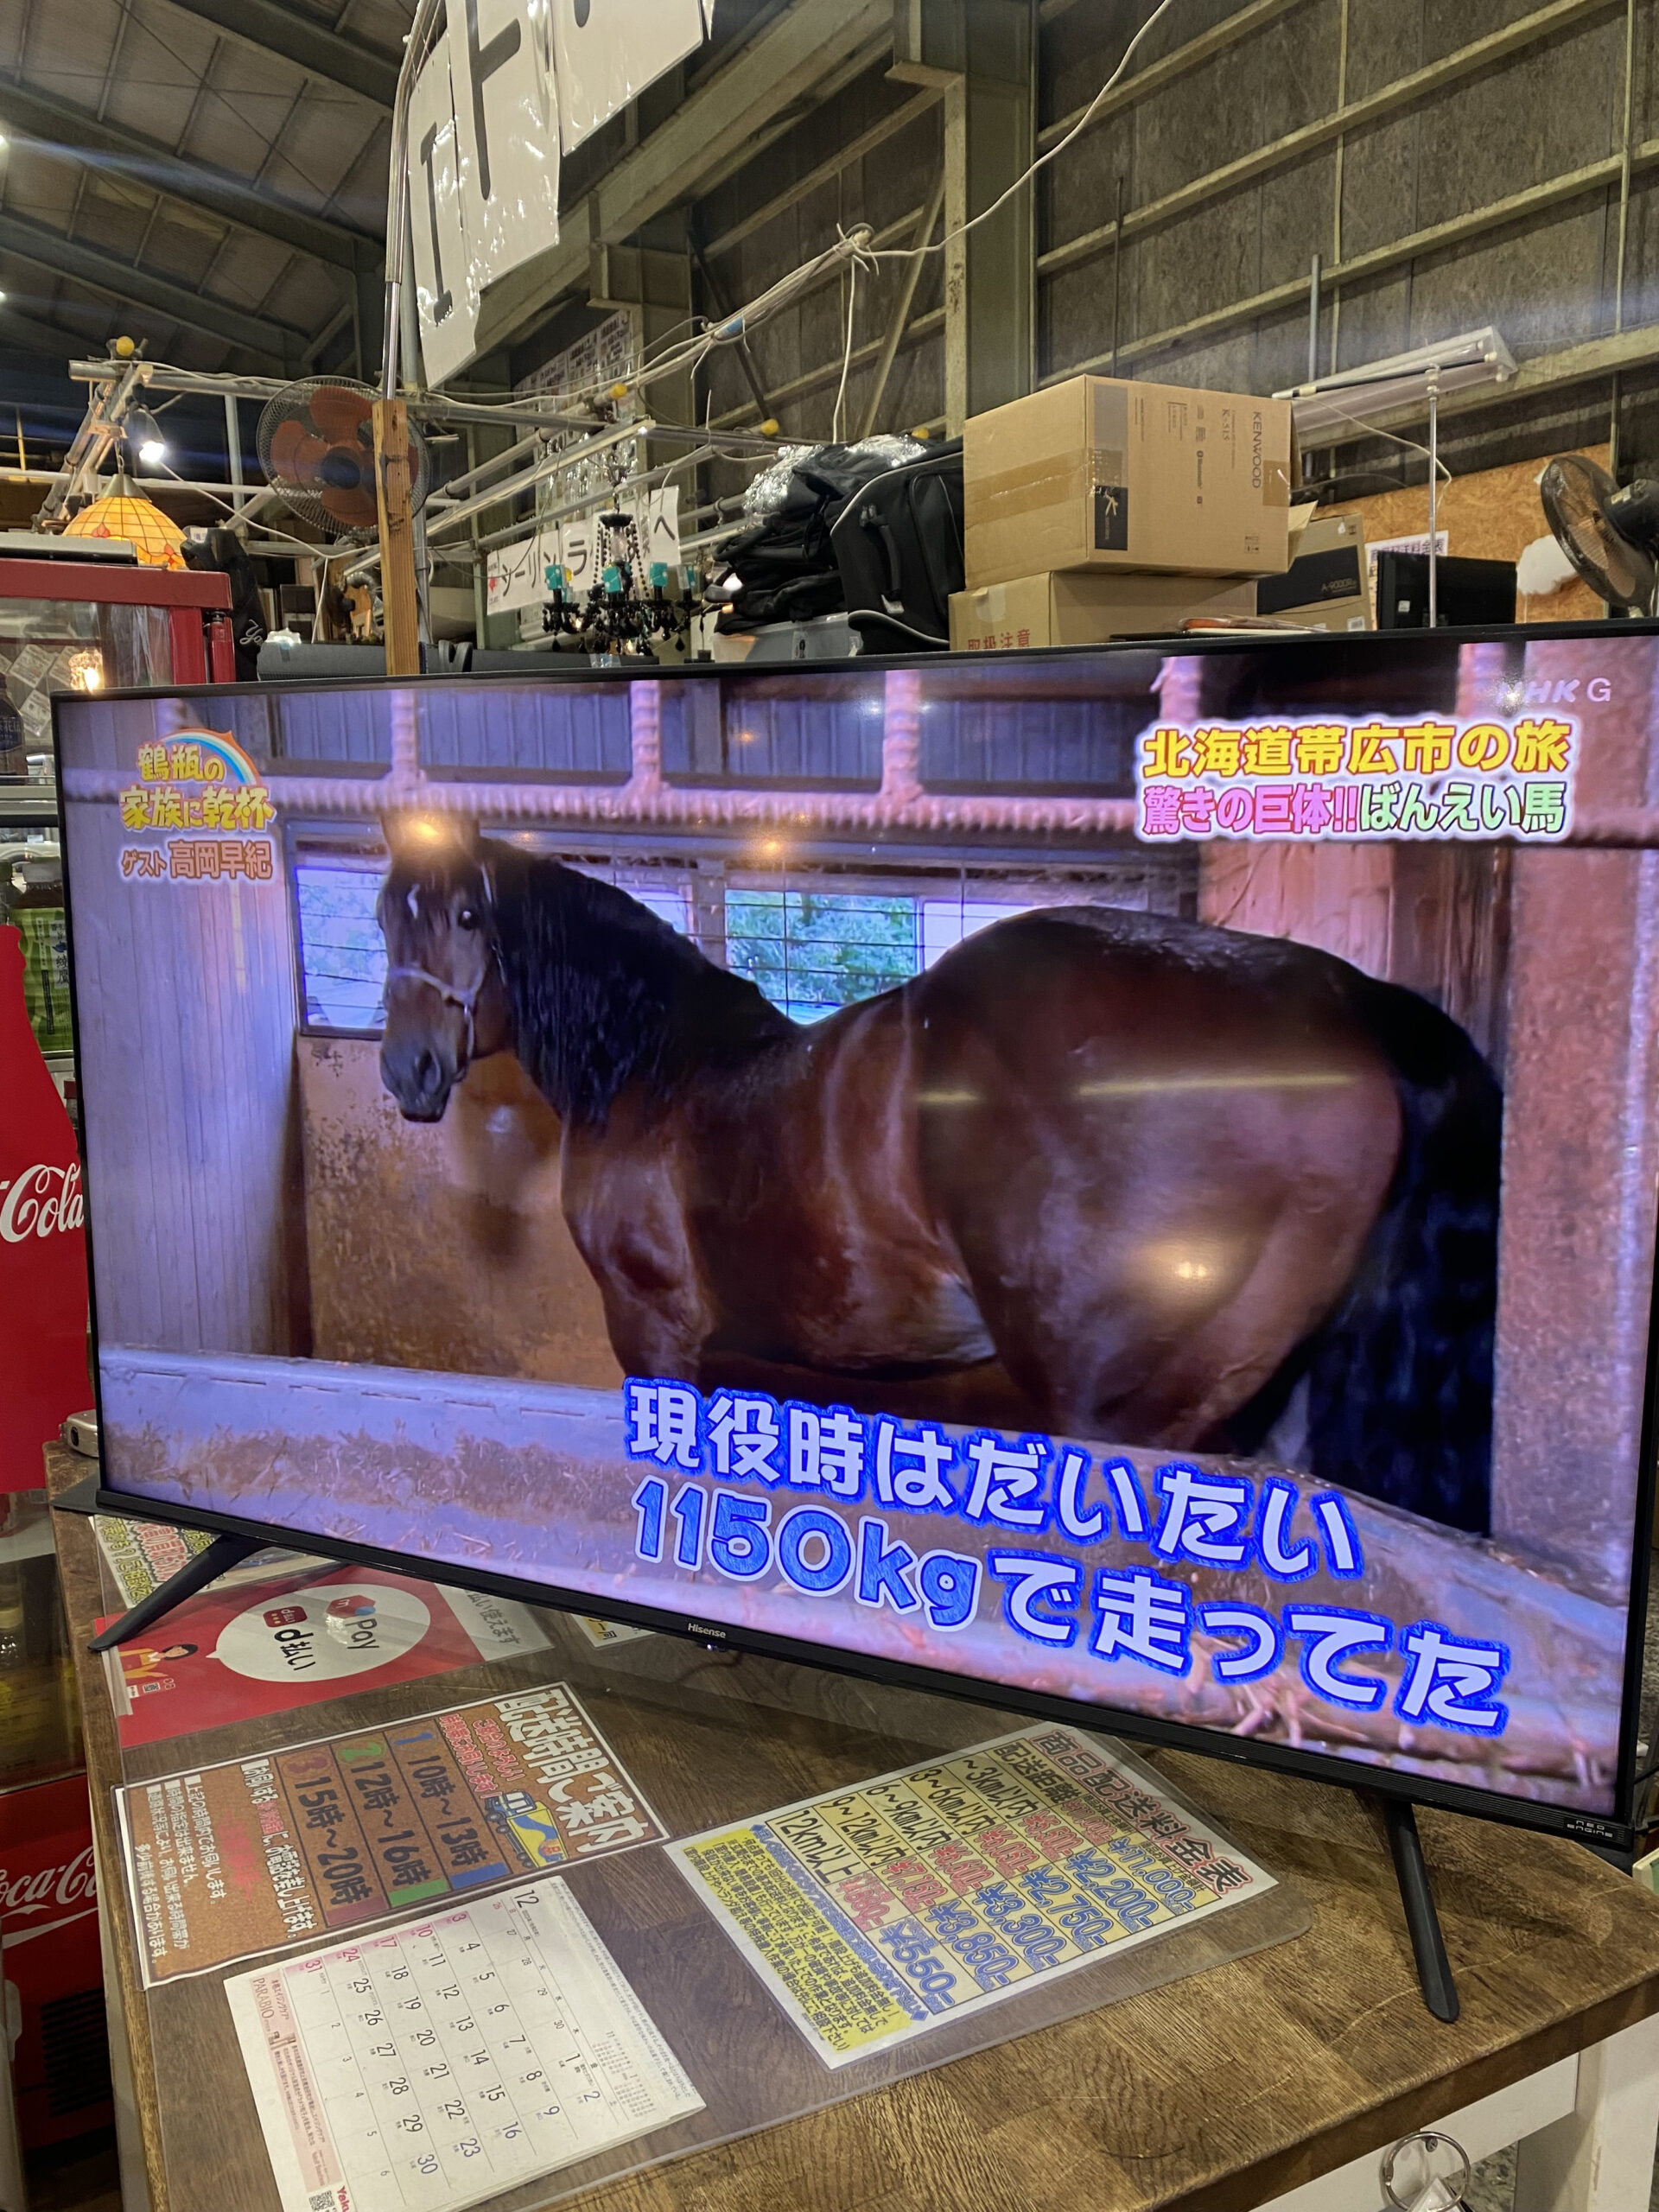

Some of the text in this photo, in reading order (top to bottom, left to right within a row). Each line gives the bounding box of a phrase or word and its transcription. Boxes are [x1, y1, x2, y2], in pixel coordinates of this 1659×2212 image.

[1252, 411, 1262, 489] KENWOOD
[1586, 677, 1612, 702] G
[137, 743, 226, 782] 鶴瓶の
[1142, 720, 1572, 778] 北海道帯広市の旅
[119, 785, 276, 830] 家族に乾杯
[122, 840, 273, 880] ゲスト 高岡早紀
[624, 1378, 1363, 1582] 現役時はだいたい
[333, 1618, 393, 1653] Pay
[632, 1475, 1510, 1734] 1150kgで走ってた
[687, 1621, 728, 1639] Hisense
[270, 1625, 331, 1671] d払い
[468, 1717, 526, 1783] ご都合のよろしい
[491, 1688, 657, 1855] 配送時間ご案内
[989, 1742, 1084, 1804] 配送距離
[291, 1775, 376, 1908] 15時～20時
[346, 1759, 435, 1890] 12時～16時
[404, 1753, 492, 1870] 10時～13時
[1023, 1729, 1259, 1894] 商品配送料金表
[512, 1889, 540, 1909] 12
[962, 1882, 1081, 1972] ¥3,300-
[1009, 1866, 1128, 1952] ¥2,750-
[1053, 1849, 1174, 1933] ¥2,200-
[870, 1920, 976, 2010] ¥550-
[914, 1900, 1031, 1992] ¥3,850-
[250, 1977, 276, 2019] PARABIO
[463, 1941, 480, 1951] 4
[478, 1971, 495, 1981] 5
[493, 2002, 510, 2013] 6
[507, 2034, 525, 2046] 7
[524, 2069, 543, 2082] 8
[541, 2105, 561, 2118] 9
[520, 1957, 531, 1966] 28
[536, 1987, 548, 1996] 29
[552, 2019, 565, 2030] 30
[563, 2053, 581, 2063] 1
[582, 2089, 601, 2102] 2
[352, 1977, 372, 1994] 25
[363, 2009, 384, 2026] 26
[375, 2042, 396, 2060] 27
[387, 2075, 410, 2096] 28
[400, 2114, 423, 2135] 29
[415, 2153, 438, 2176] 30
[390, 1965, 409, 1980] 18
[402, 1996, 422, 2012] 19
[415, 2028, 436, 2047] 20
[428, 2062, 449, 2080] 21
[442, 2099, 466, 2120] 22
[458, 2137, 481, 2158] 23
[427, 1953, 446, 1967] 11
[440, 1984, 460, 1999] 12
[454, 2015, 474, 2032] 13
[468, 2049, 490, 2066] 14
[484, 2084, 505, 2102] 15
[499, 2121, 523, 2140] 16
[378, 2169, 391, 2177] 6
